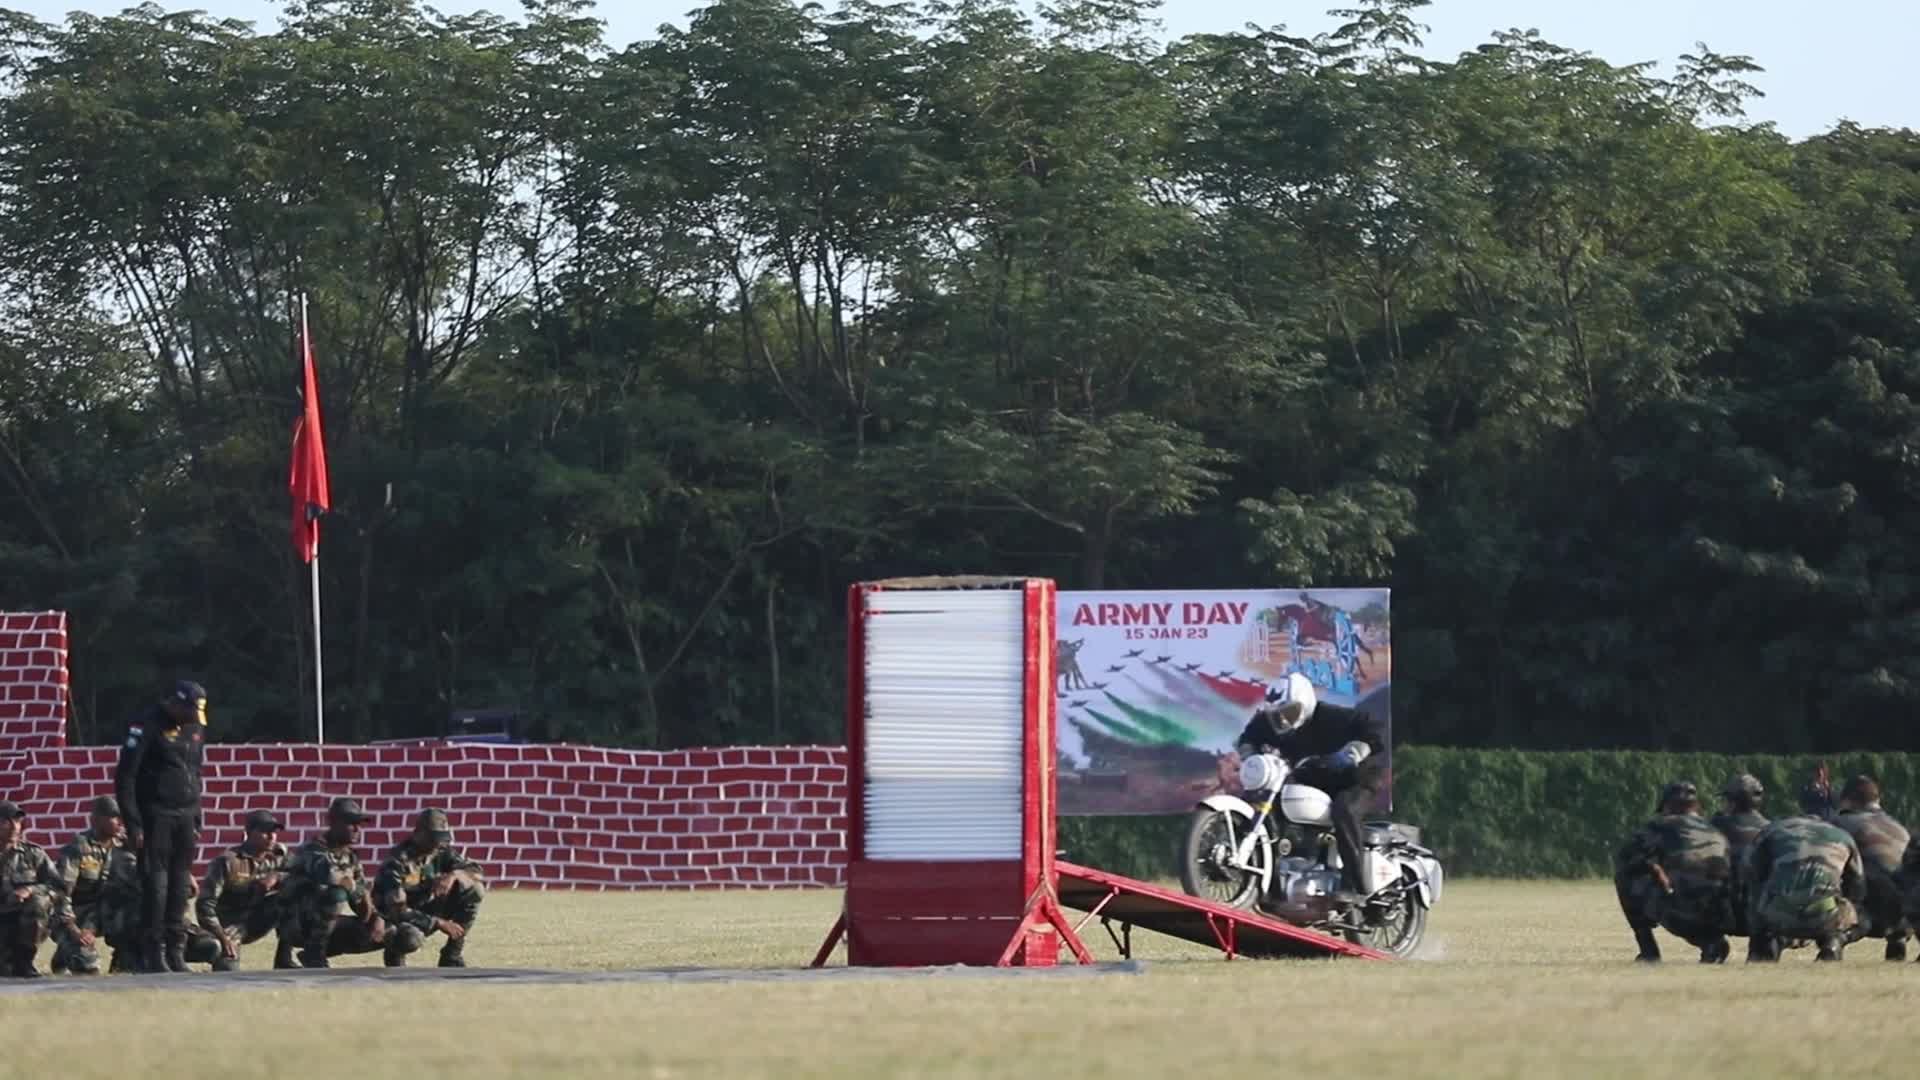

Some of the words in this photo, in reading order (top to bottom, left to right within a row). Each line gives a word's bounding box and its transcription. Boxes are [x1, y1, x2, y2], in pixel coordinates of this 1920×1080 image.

[1072, 602, 1173, 626] ARMY
[1183, 602, 1249, 625] DAY
[1125, 628, 1145, 640] 15
[1149, 627, 1182, 640] JAN
[1186, 627, 1209, 639] 23
